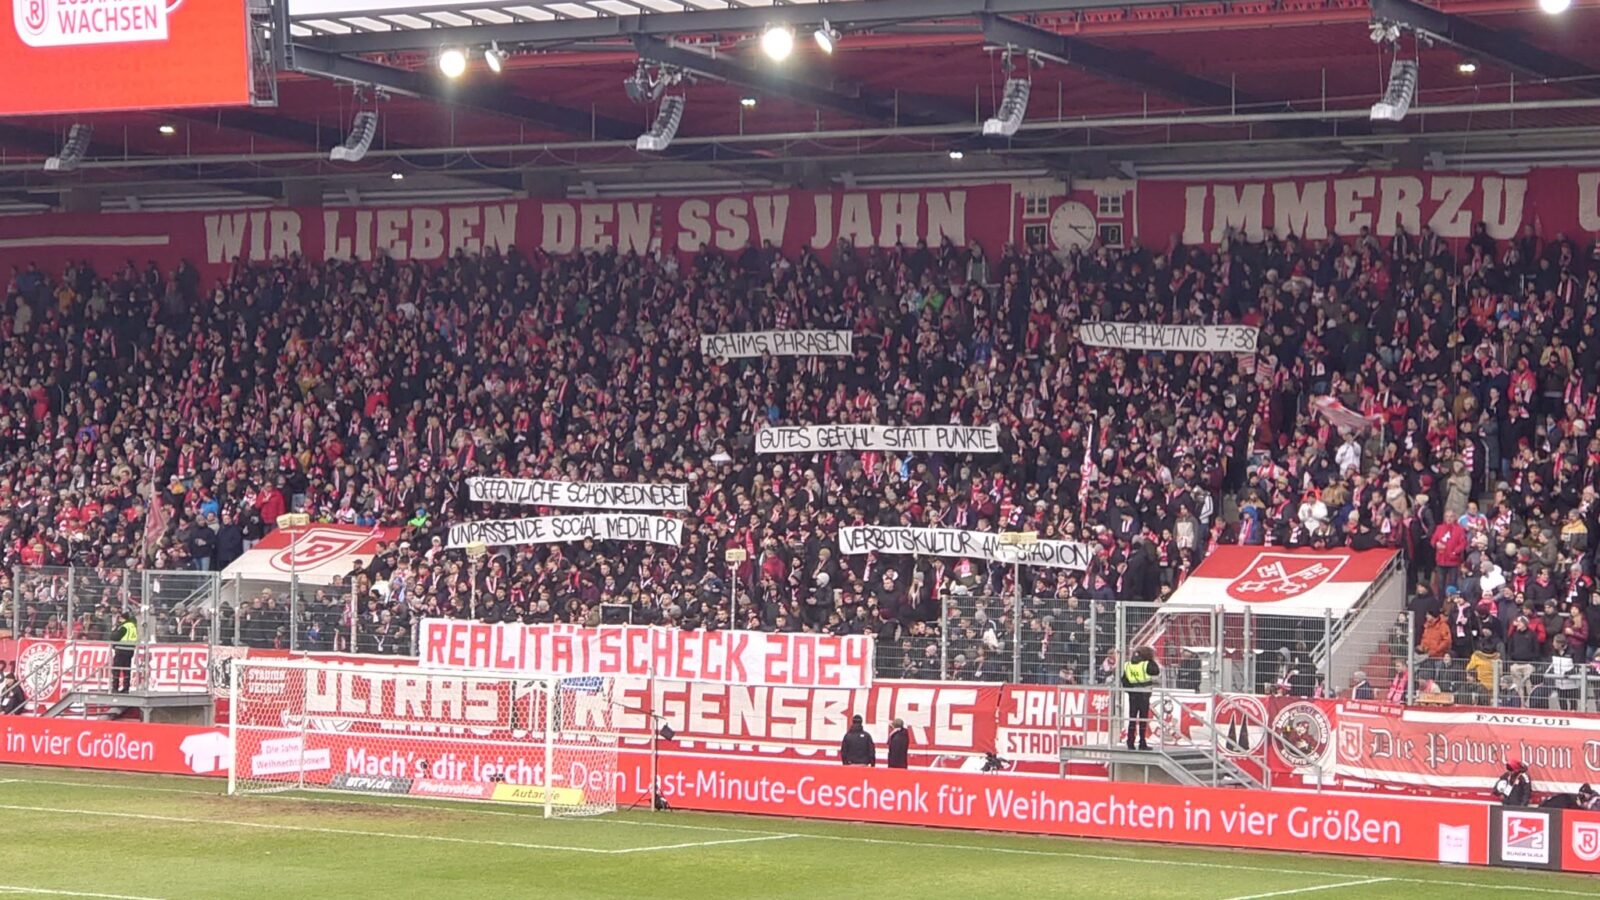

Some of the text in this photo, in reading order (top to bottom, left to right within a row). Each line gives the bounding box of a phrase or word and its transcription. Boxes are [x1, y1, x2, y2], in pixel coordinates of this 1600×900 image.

[57, 5, 157, 34] WACHSEN
[204, 210, 301, 263] WIR
[323, 204, 518, 261] LIEBEN
[541, 202, 653, 256] DEN
[678, 196, 790, 251] SSV
[811, 191, 967, 249] JAHN
[1183, 172, 1527, 244] IMMERZU
[706, 332, 849, 354] ACHIMS PHRASEN
[1083, 322, 1256, 350] TORVERHÄLTNIS 7:38
[760, 427, 811, 449] GUTES
[883, 427, 930, 448] STATT
[937, 427, 996, 449] PUNKTE
[474, 478, 688, 506] ÖFFENTLICHE SCHÖNREDNEREI
[451, 515, 678, 545] UNPASSENDE SOCIAL MEDIA PR
[843, 529, 976, 553] VERBOTSKULTUR
[427, 623, 867, 686] REALITÄTSCHECK 2024
[304, 664, 977, 748] ULTRAS REGENSBURG
[1007, 690, 1085, 728] JAHN
[1476, 714, 1571, 726] FANCLUB
[7, 729, 153, 760] in vier Größen
[1369, 727, 1414, 760] Die
[1425, 732, 1510, 768] Power
[1520, 738, 1572, 769] vom
[256, 757, 326, 769] Weihnachtoxen
[346, 748, 425, 776] Mach's
[432, 753, 466, 782] dir
[473, 756, 546, 785] leicht
[571, 762, 625, 792] Dein
[635, 766, 928, 814] Last-Minute-Geschenk
[937, 785, 977, 813] für
[985, 787, 1174, 830] Weihnachten
[1184, 800, 1211, 832] in
[1220, 804, 1278, 836] vier
[1287, 807, 1400, 844] Größen
[512, 789, 560, 802] Autarie
